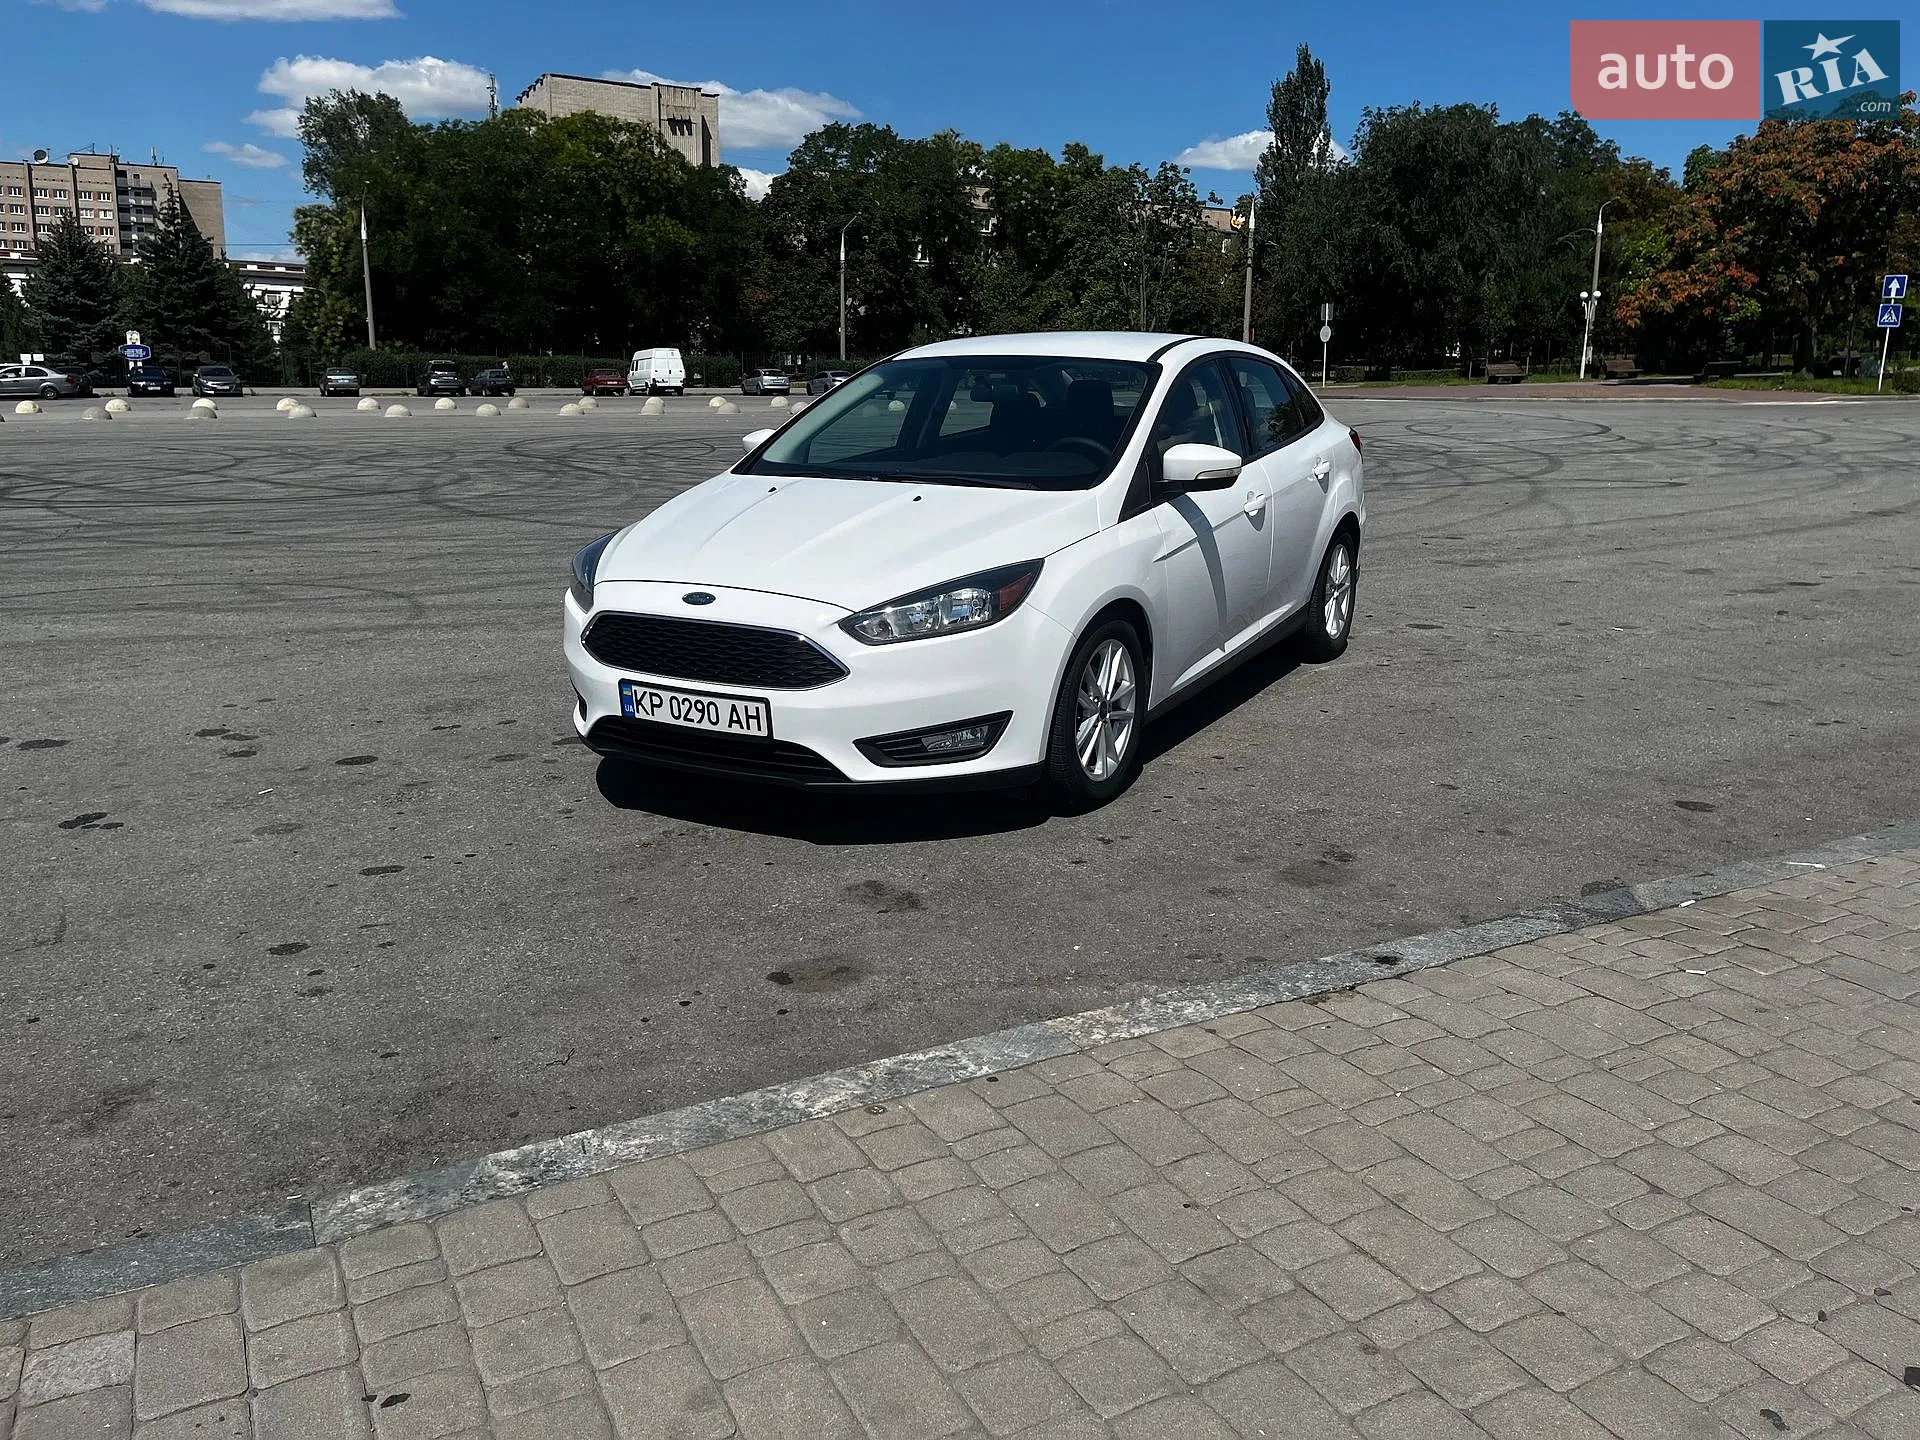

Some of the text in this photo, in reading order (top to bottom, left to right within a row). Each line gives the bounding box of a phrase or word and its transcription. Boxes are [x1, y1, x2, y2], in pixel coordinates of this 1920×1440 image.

[624, 703, 634, 713] UA
[633, 689, 762, 732] KP 0290 AH
